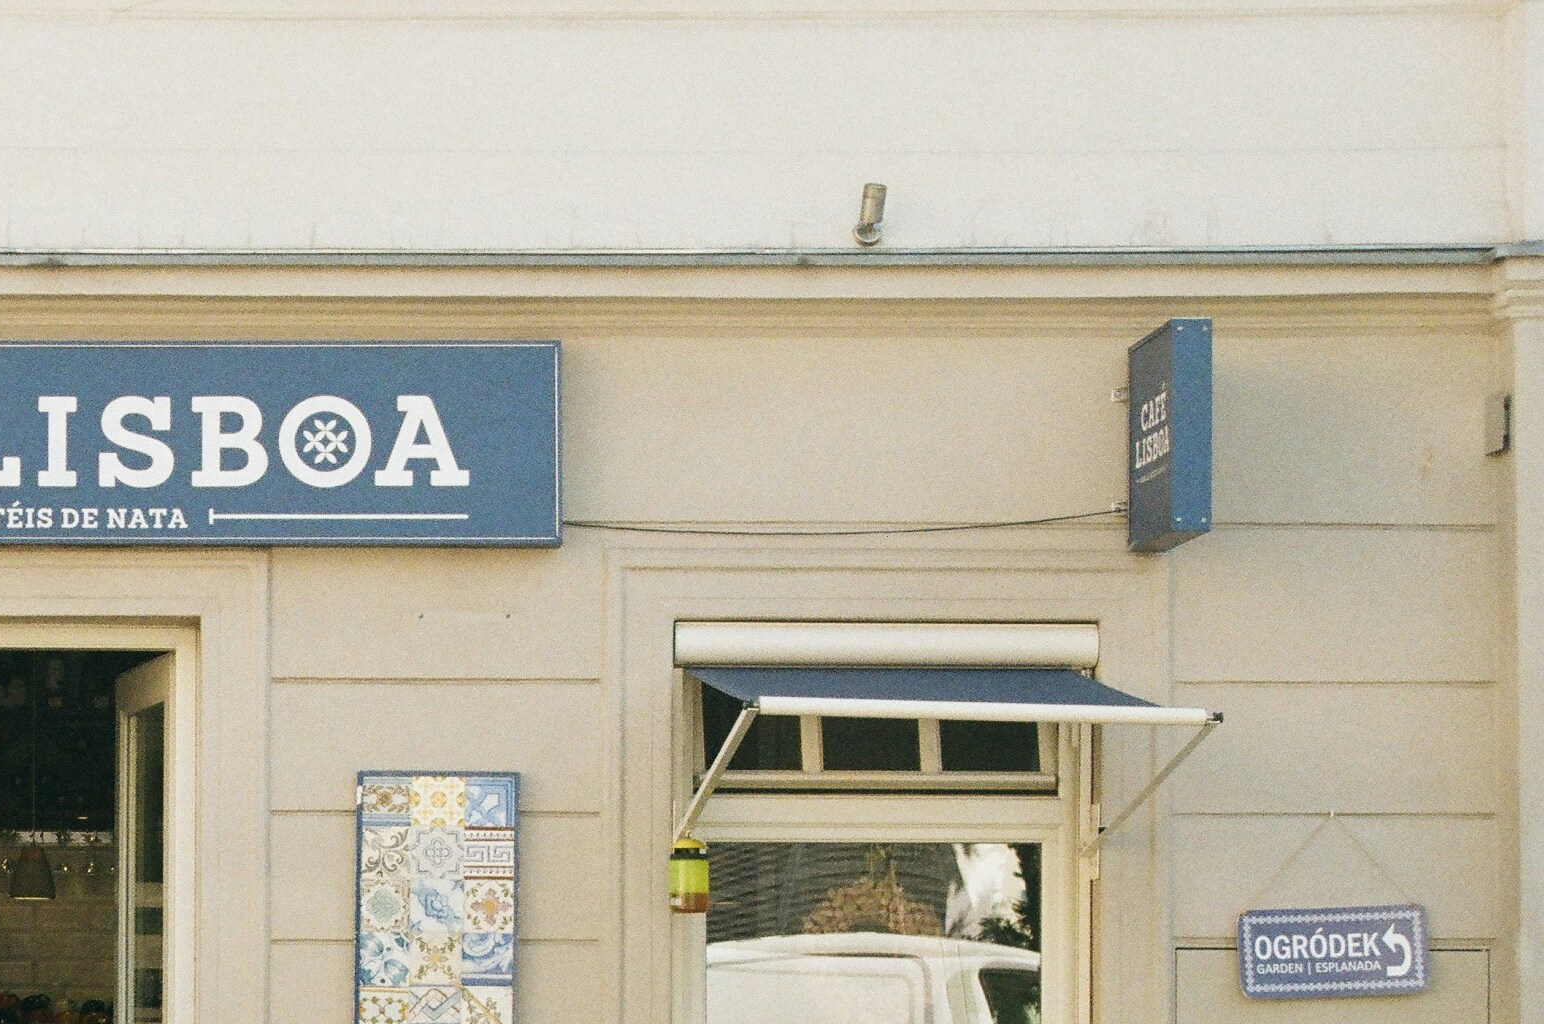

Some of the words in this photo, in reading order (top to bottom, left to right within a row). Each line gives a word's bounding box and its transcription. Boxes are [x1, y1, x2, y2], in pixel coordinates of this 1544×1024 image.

[1135, 425, 1171, 469] LISBOA
[60, 507, 99, 529] DE
[106, 507, 189, 530] NATA
[1255, 926, 1382, 961] OGRÓDEK
[1256, 963, 1304, 975] GARDEN
[1315, 960, 1382, 974] ESPLANADA
